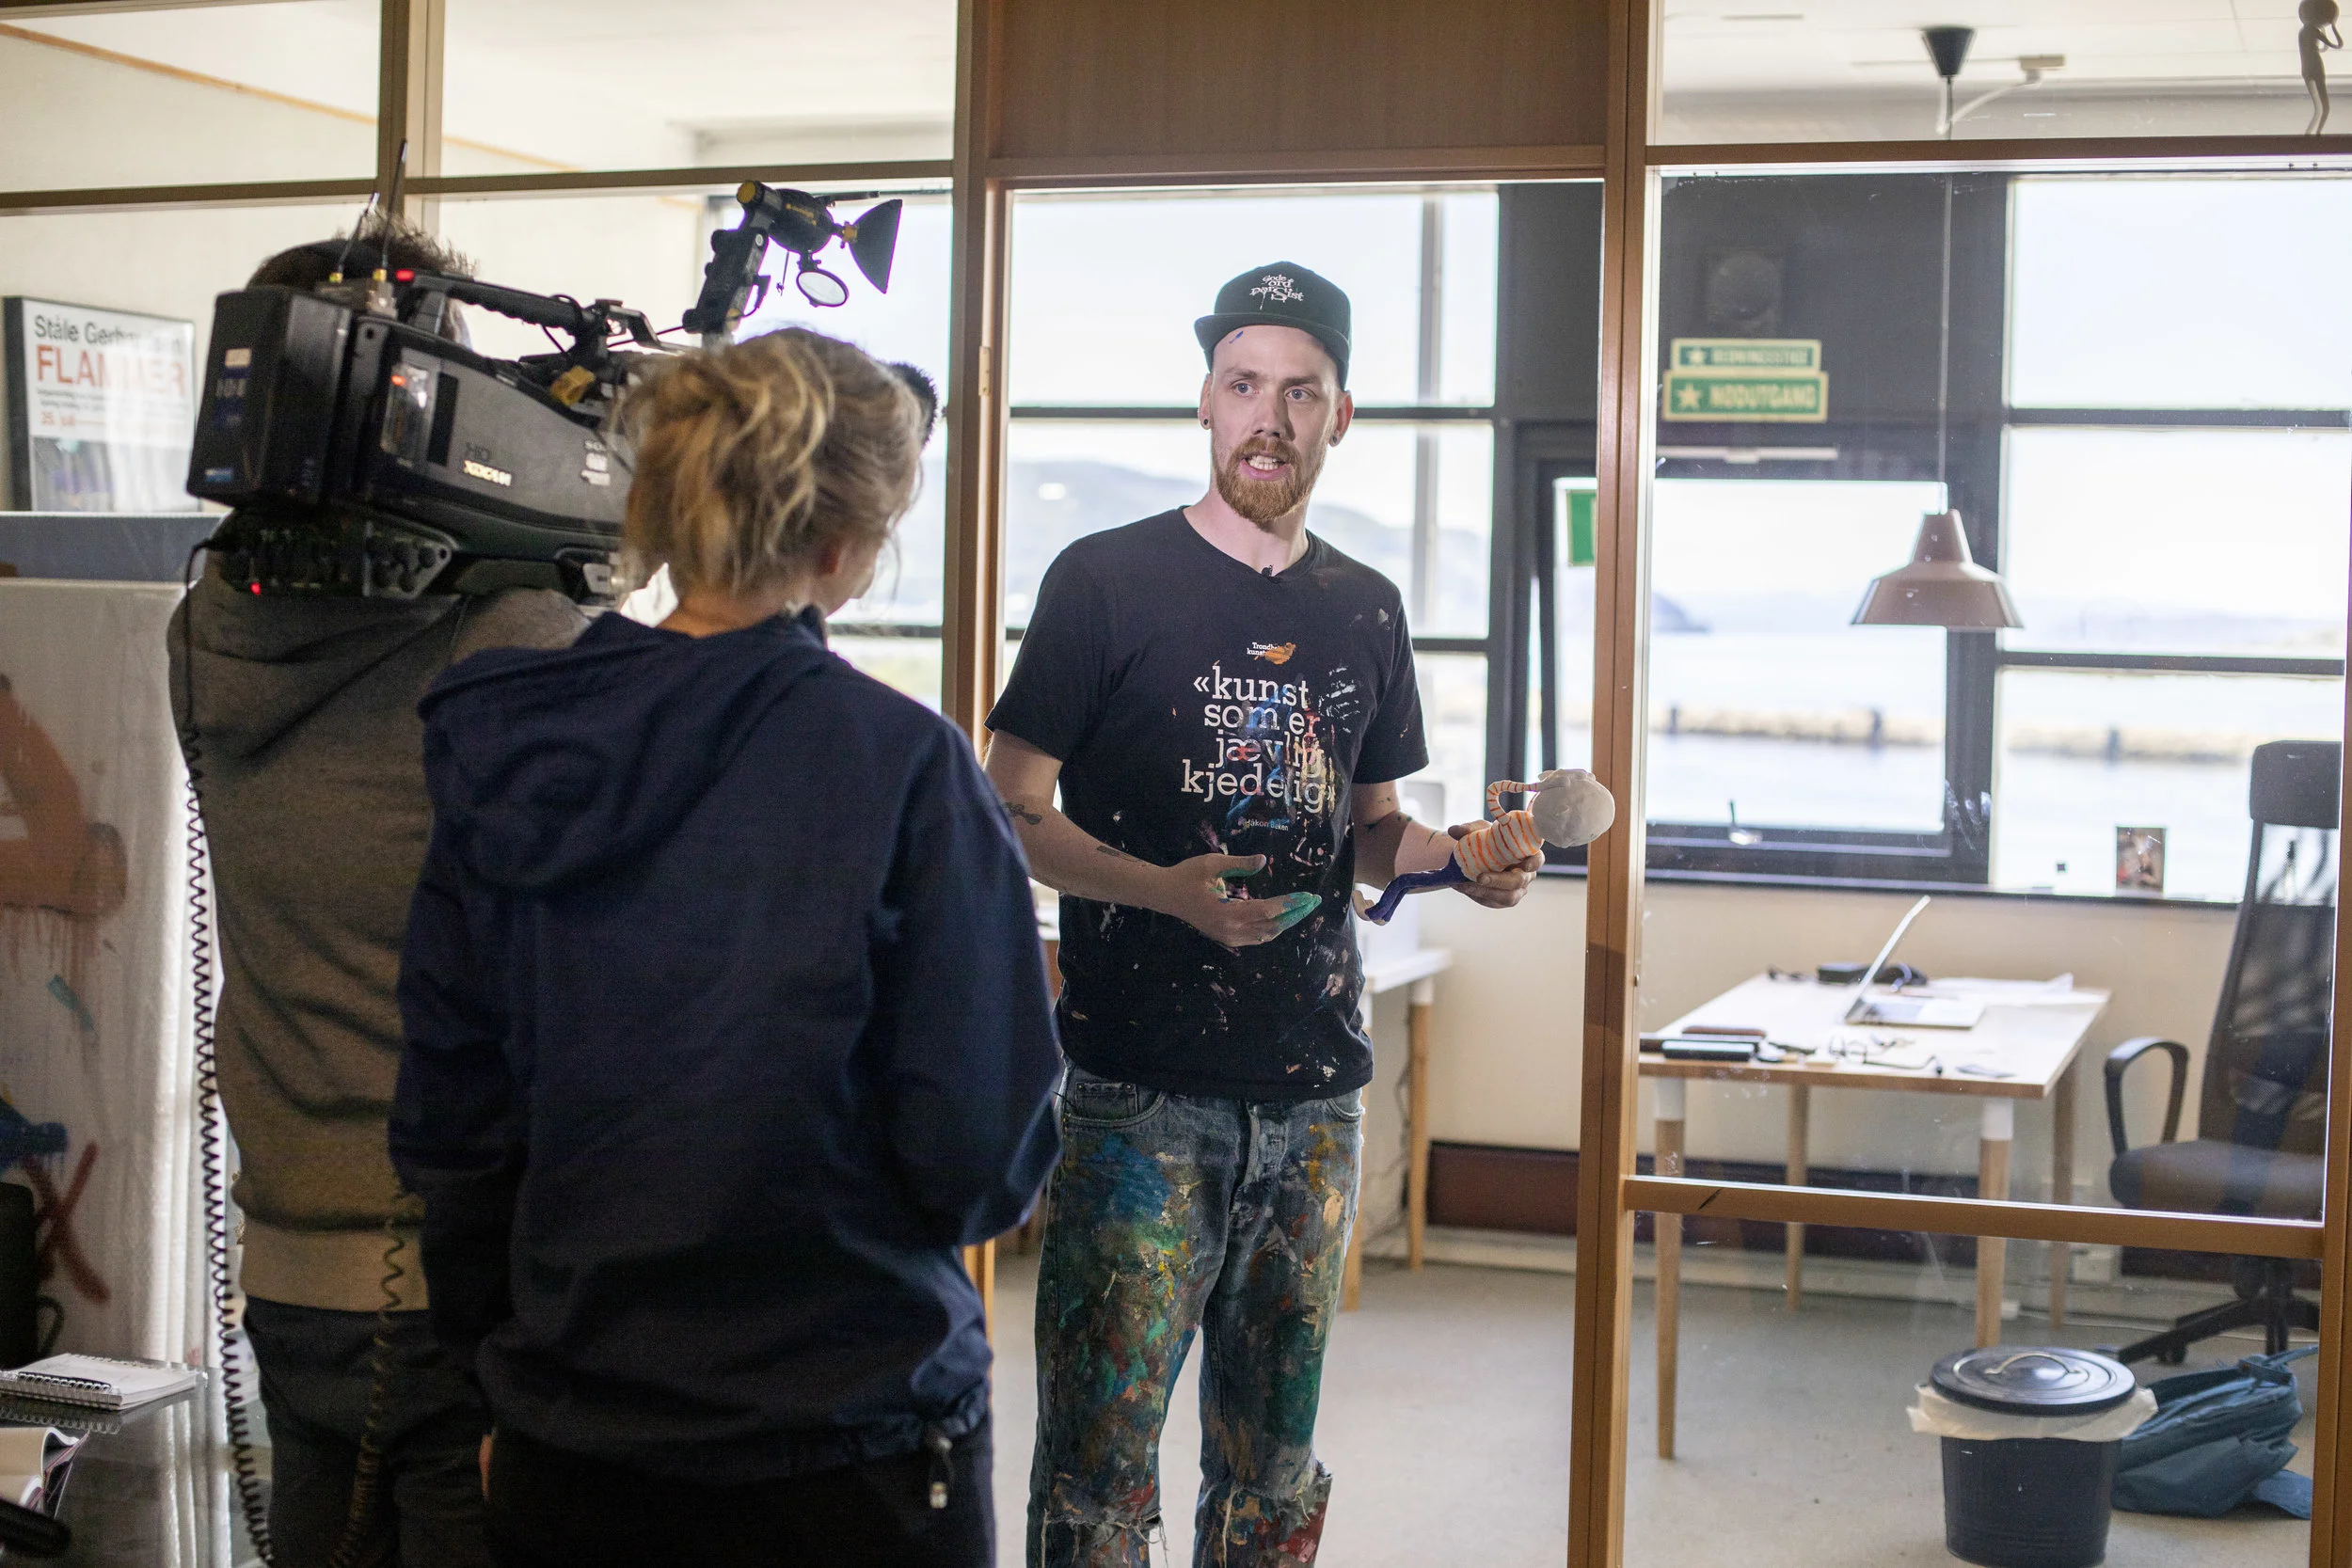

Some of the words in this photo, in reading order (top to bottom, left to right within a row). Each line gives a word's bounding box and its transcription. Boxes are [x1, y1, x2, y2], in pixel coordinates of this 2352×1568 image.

[1193, 665, 1309, 708] «kunst
[1203, 704, 1280, 730] som
[1288, 711, 1320, 737] er
